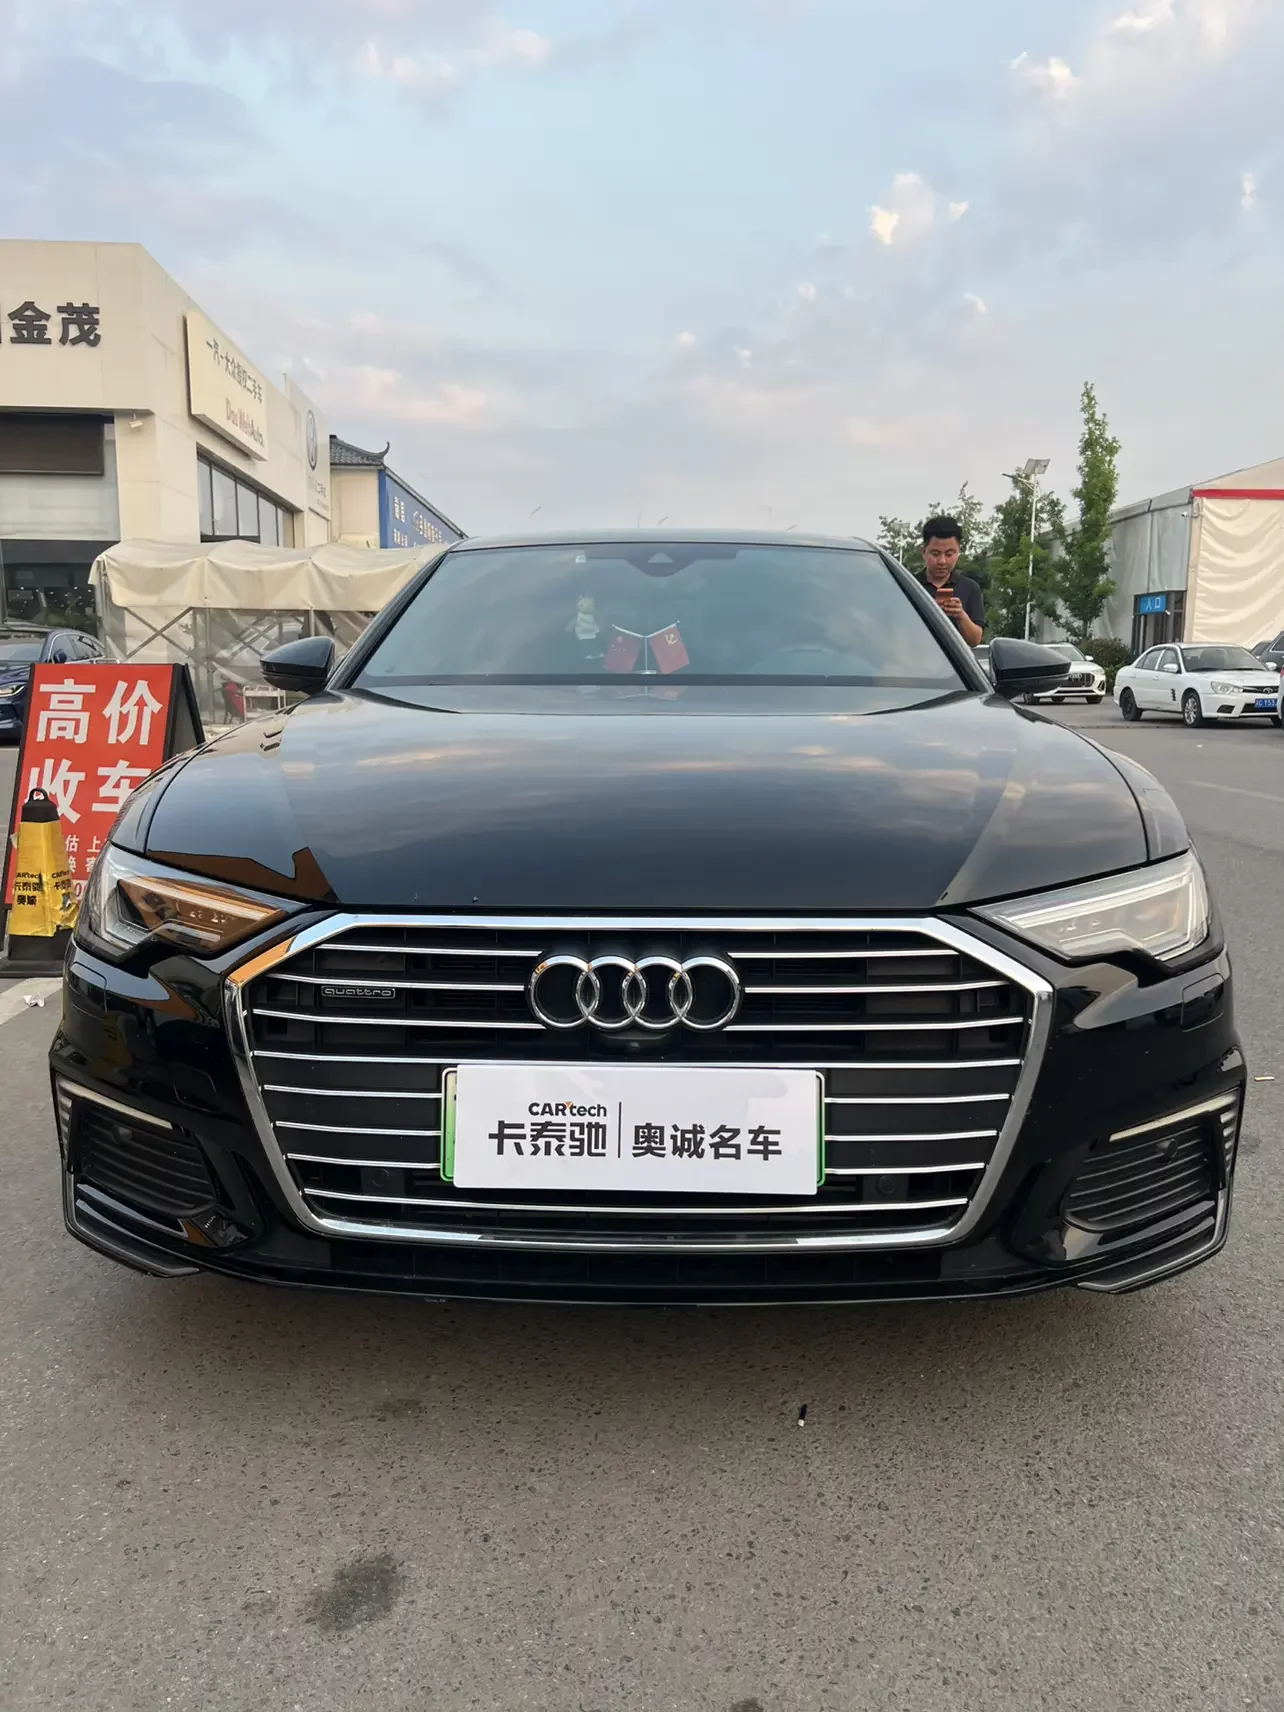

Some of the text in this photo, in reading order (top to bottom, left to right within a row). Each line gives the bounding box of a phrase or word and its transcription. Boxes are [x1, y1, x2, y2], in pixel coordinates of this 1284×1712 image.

[0, 301, 101, 347] 金茂
[1145, 597, 1161, 610] 入口
[324, 988, 392, 996] quattro
[488, 1120, 782, 1161] 卡泰驰 奥诚名车
